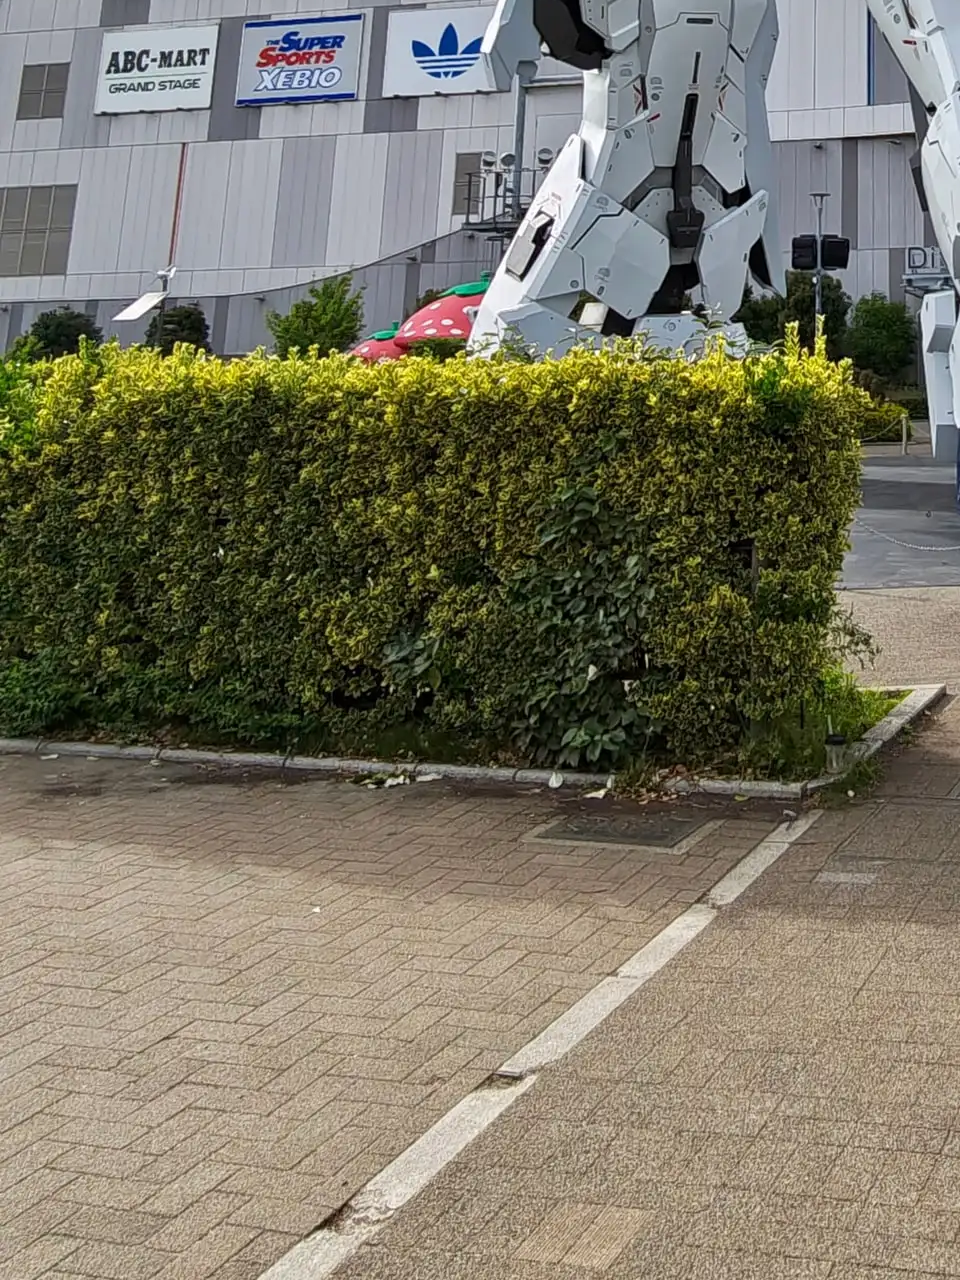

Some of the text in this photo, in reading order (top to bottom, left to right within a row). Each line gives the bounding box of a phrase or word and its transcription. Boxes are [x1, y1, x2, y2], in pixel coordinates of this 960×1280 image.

[266, 31, 346, 52] THE SUPER
[105, 48, 210, 75] ABC-MART
[255, 47, 337, 68] SPORTS
[109, 78, 201, 94] GRAND STAGE
[253, 67, 343, 92] XEBIO
